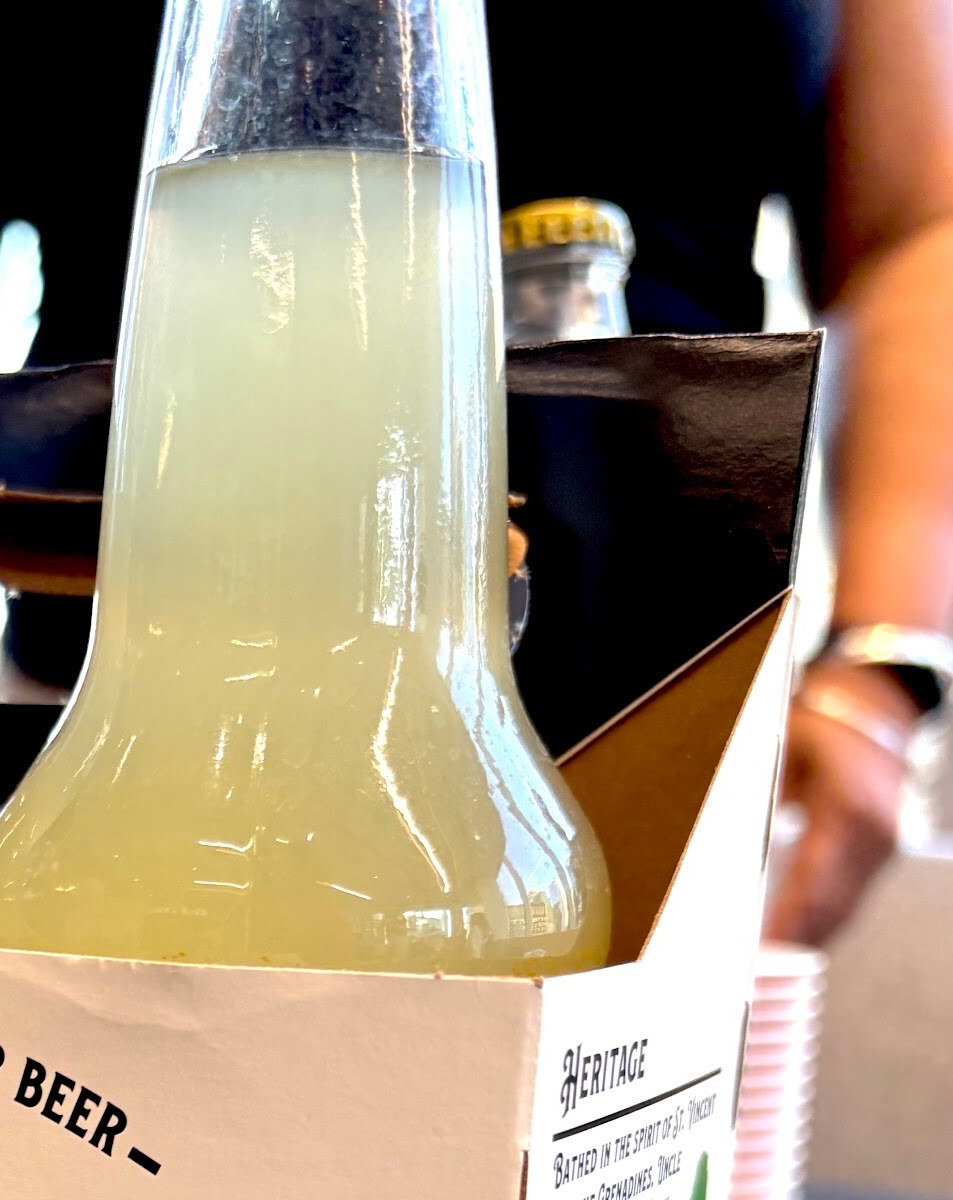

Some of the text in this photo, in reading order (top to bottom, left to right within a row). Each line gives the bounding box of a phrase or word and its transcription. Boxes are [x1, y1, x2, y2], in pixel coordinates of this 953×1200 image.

[13, 1057, 129, 1158] BEER
[559, 1038, 649, 1119] HERITAGE
[553, 1148, 598, 1190] BATHED
[599, 1141, 612, 1169] IN
[614, 1133, 633, 1163] THE
[632, 1120, 662, 1155] SPIRIT
[662, 1114, 673, 1140] OF
